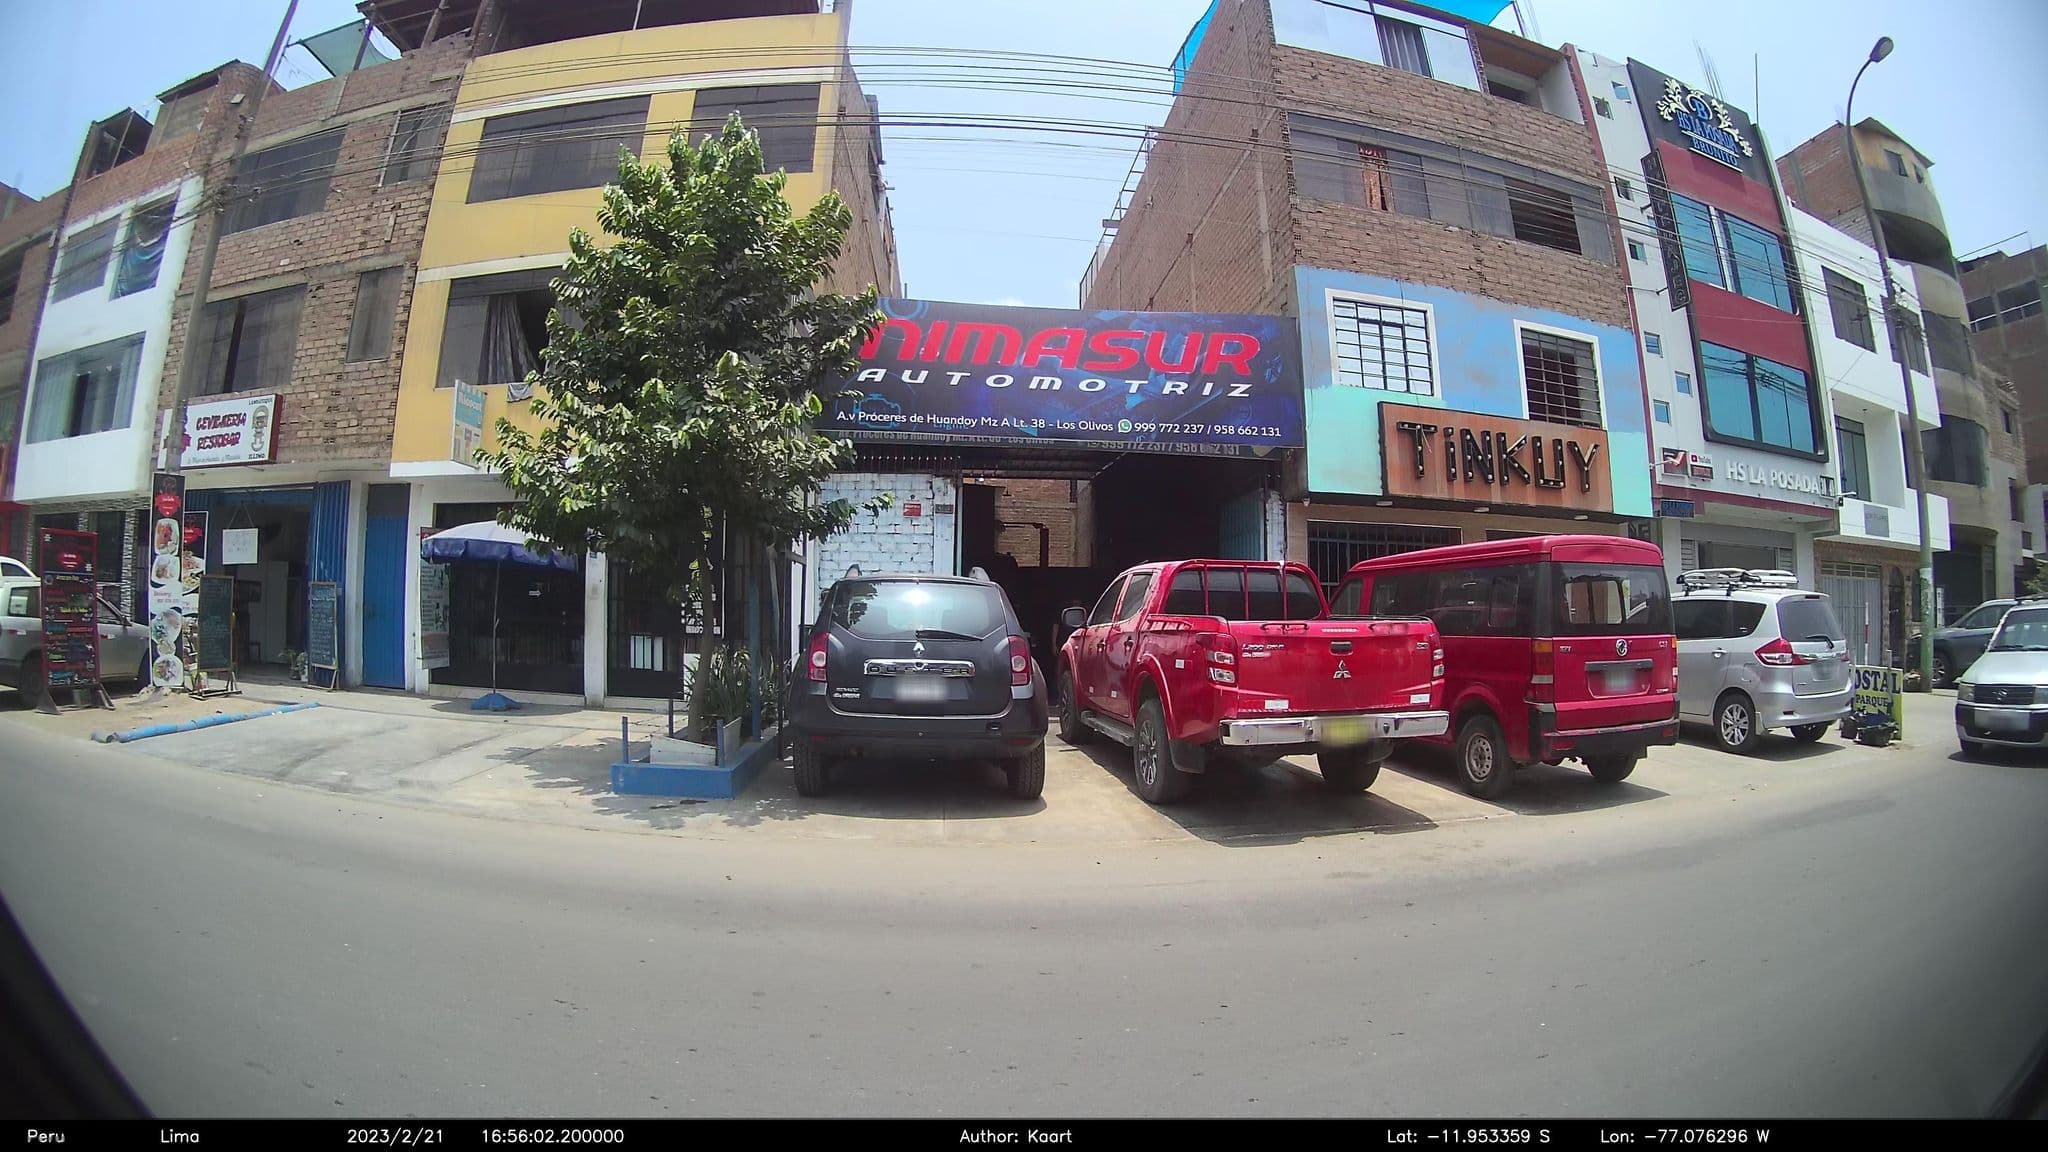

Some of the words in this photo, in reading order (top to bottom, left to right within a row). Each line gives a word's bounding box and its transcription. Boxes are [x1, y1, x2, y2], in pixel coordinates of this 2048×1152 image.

[857, 366, 1254, 398] AUTOMOTRIZ
[858, 411, 907, 423] Próceres
[909, 413, 924, 423] de
[926, 413, 979, 428] Huandoy
[981, 416, 998, 427] Mz
[1000, 417, 1010, 427] A
[1013, 418, 1027, 428] Lt.
[1031, 418, 1046, 429] 38
[1057, 419, 1076, 430] Los
[1079, 420, 1114, 431] Olivos
[1134, 422, 1156, 433] 999
[1159, 423, 1181, 434] 772
[1184, 424, 1204, 435] 237
[1206, 424, 1212, 435] /
[1214, 425, 1235, 436] 958
[1237, 425, 1258, 436] 662
[1261, 426, 1282, 437] 131
[1849, 668, 1901, 694] OSTAL
